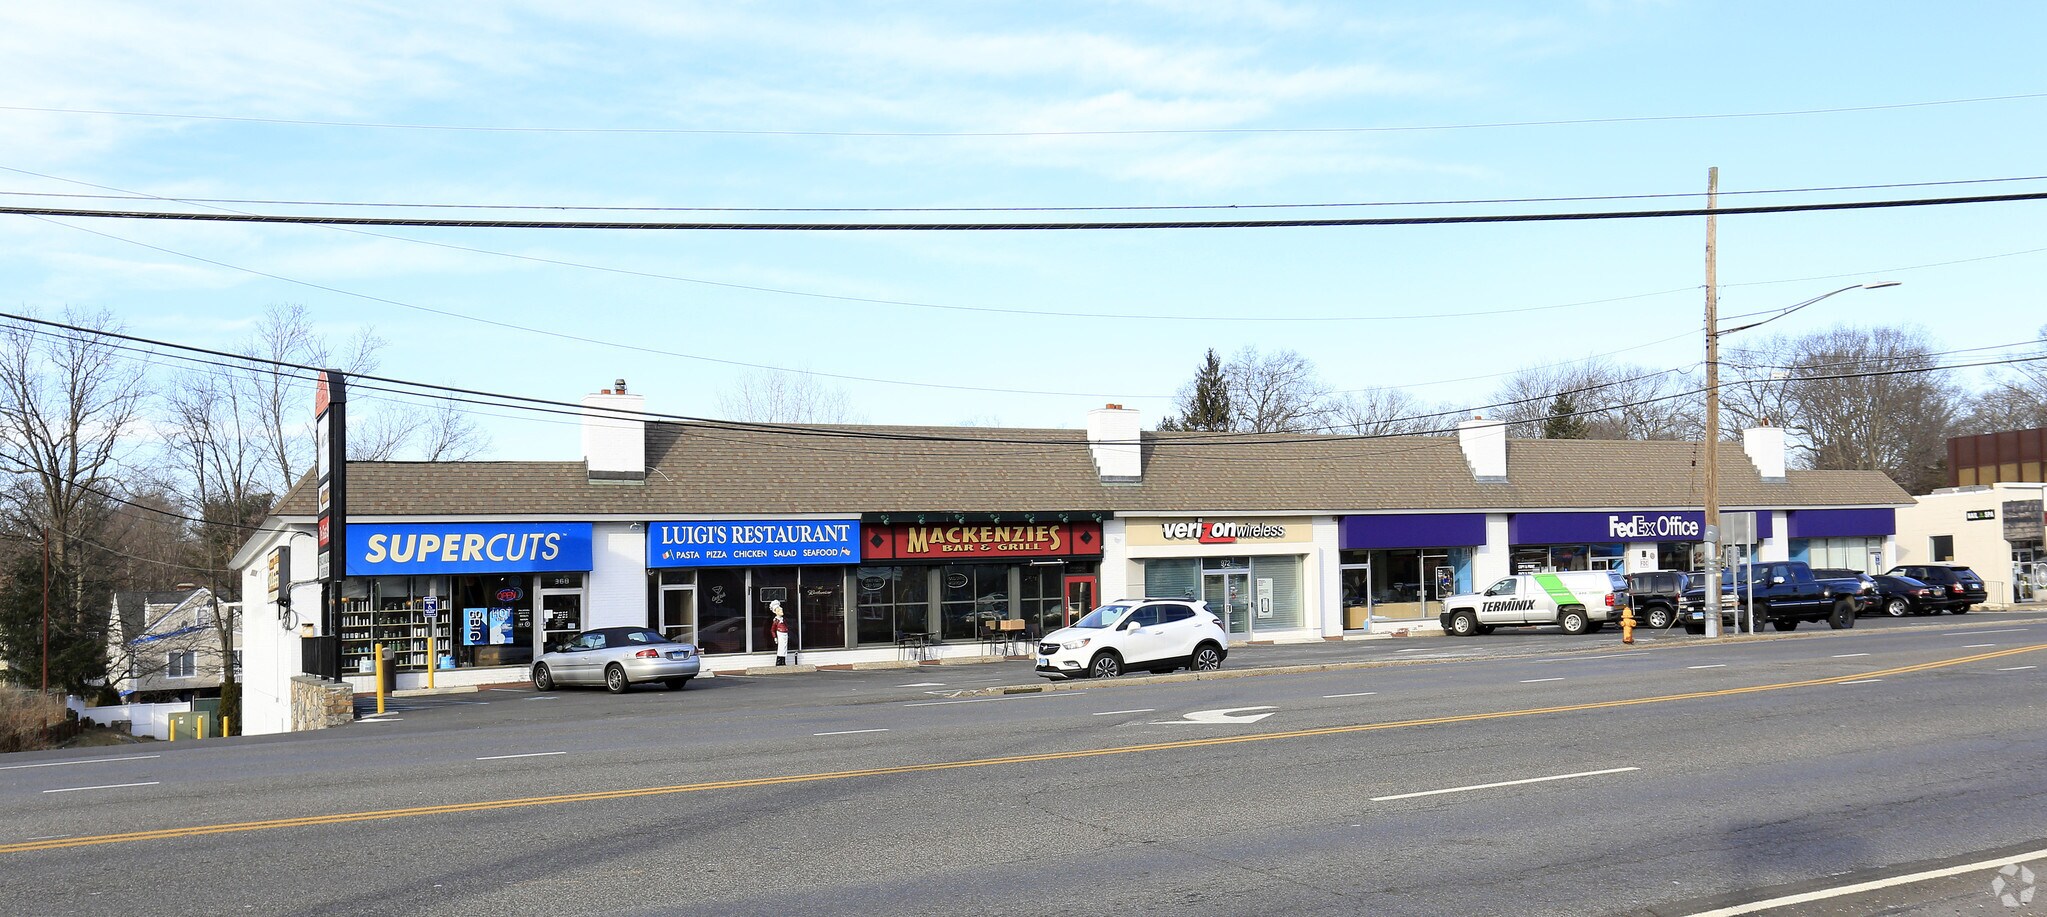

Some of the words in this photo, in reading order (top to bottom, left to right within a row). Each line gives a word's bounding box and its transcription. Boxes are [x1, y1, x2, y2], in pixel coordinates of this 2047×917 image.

[661, 525, 727, 545] LUIGI'S
[731, 524, 850, 545] RESTAURANT
[1162, 518, 1236, 544] verizon
[1236, 522, 1286, 537] wireless
[1609, 515, 1656, 537] FedEx
[1657, 515, 1699, 536] Office
[364, 532, 561, 563] SUPERCUTS
[907, 525, 1061, 553] MACKENZIES
[942, 543, 974, 552] BAR
[980, 543, 992, 551] &
[997, 543, 1042, 551] GRILL
[676, 551, 700, 560] PASTA
[706, 550, 728, 559] PIZZA
[733, 550, 768, 558] CHICKEN
[773, 549, 797, 558] SALAD
[802, 548, 838, 557] SEAFOOD
[497, 591, 516, 601] OPEN
[1482, 600, 1535, 612] TERMINIX
